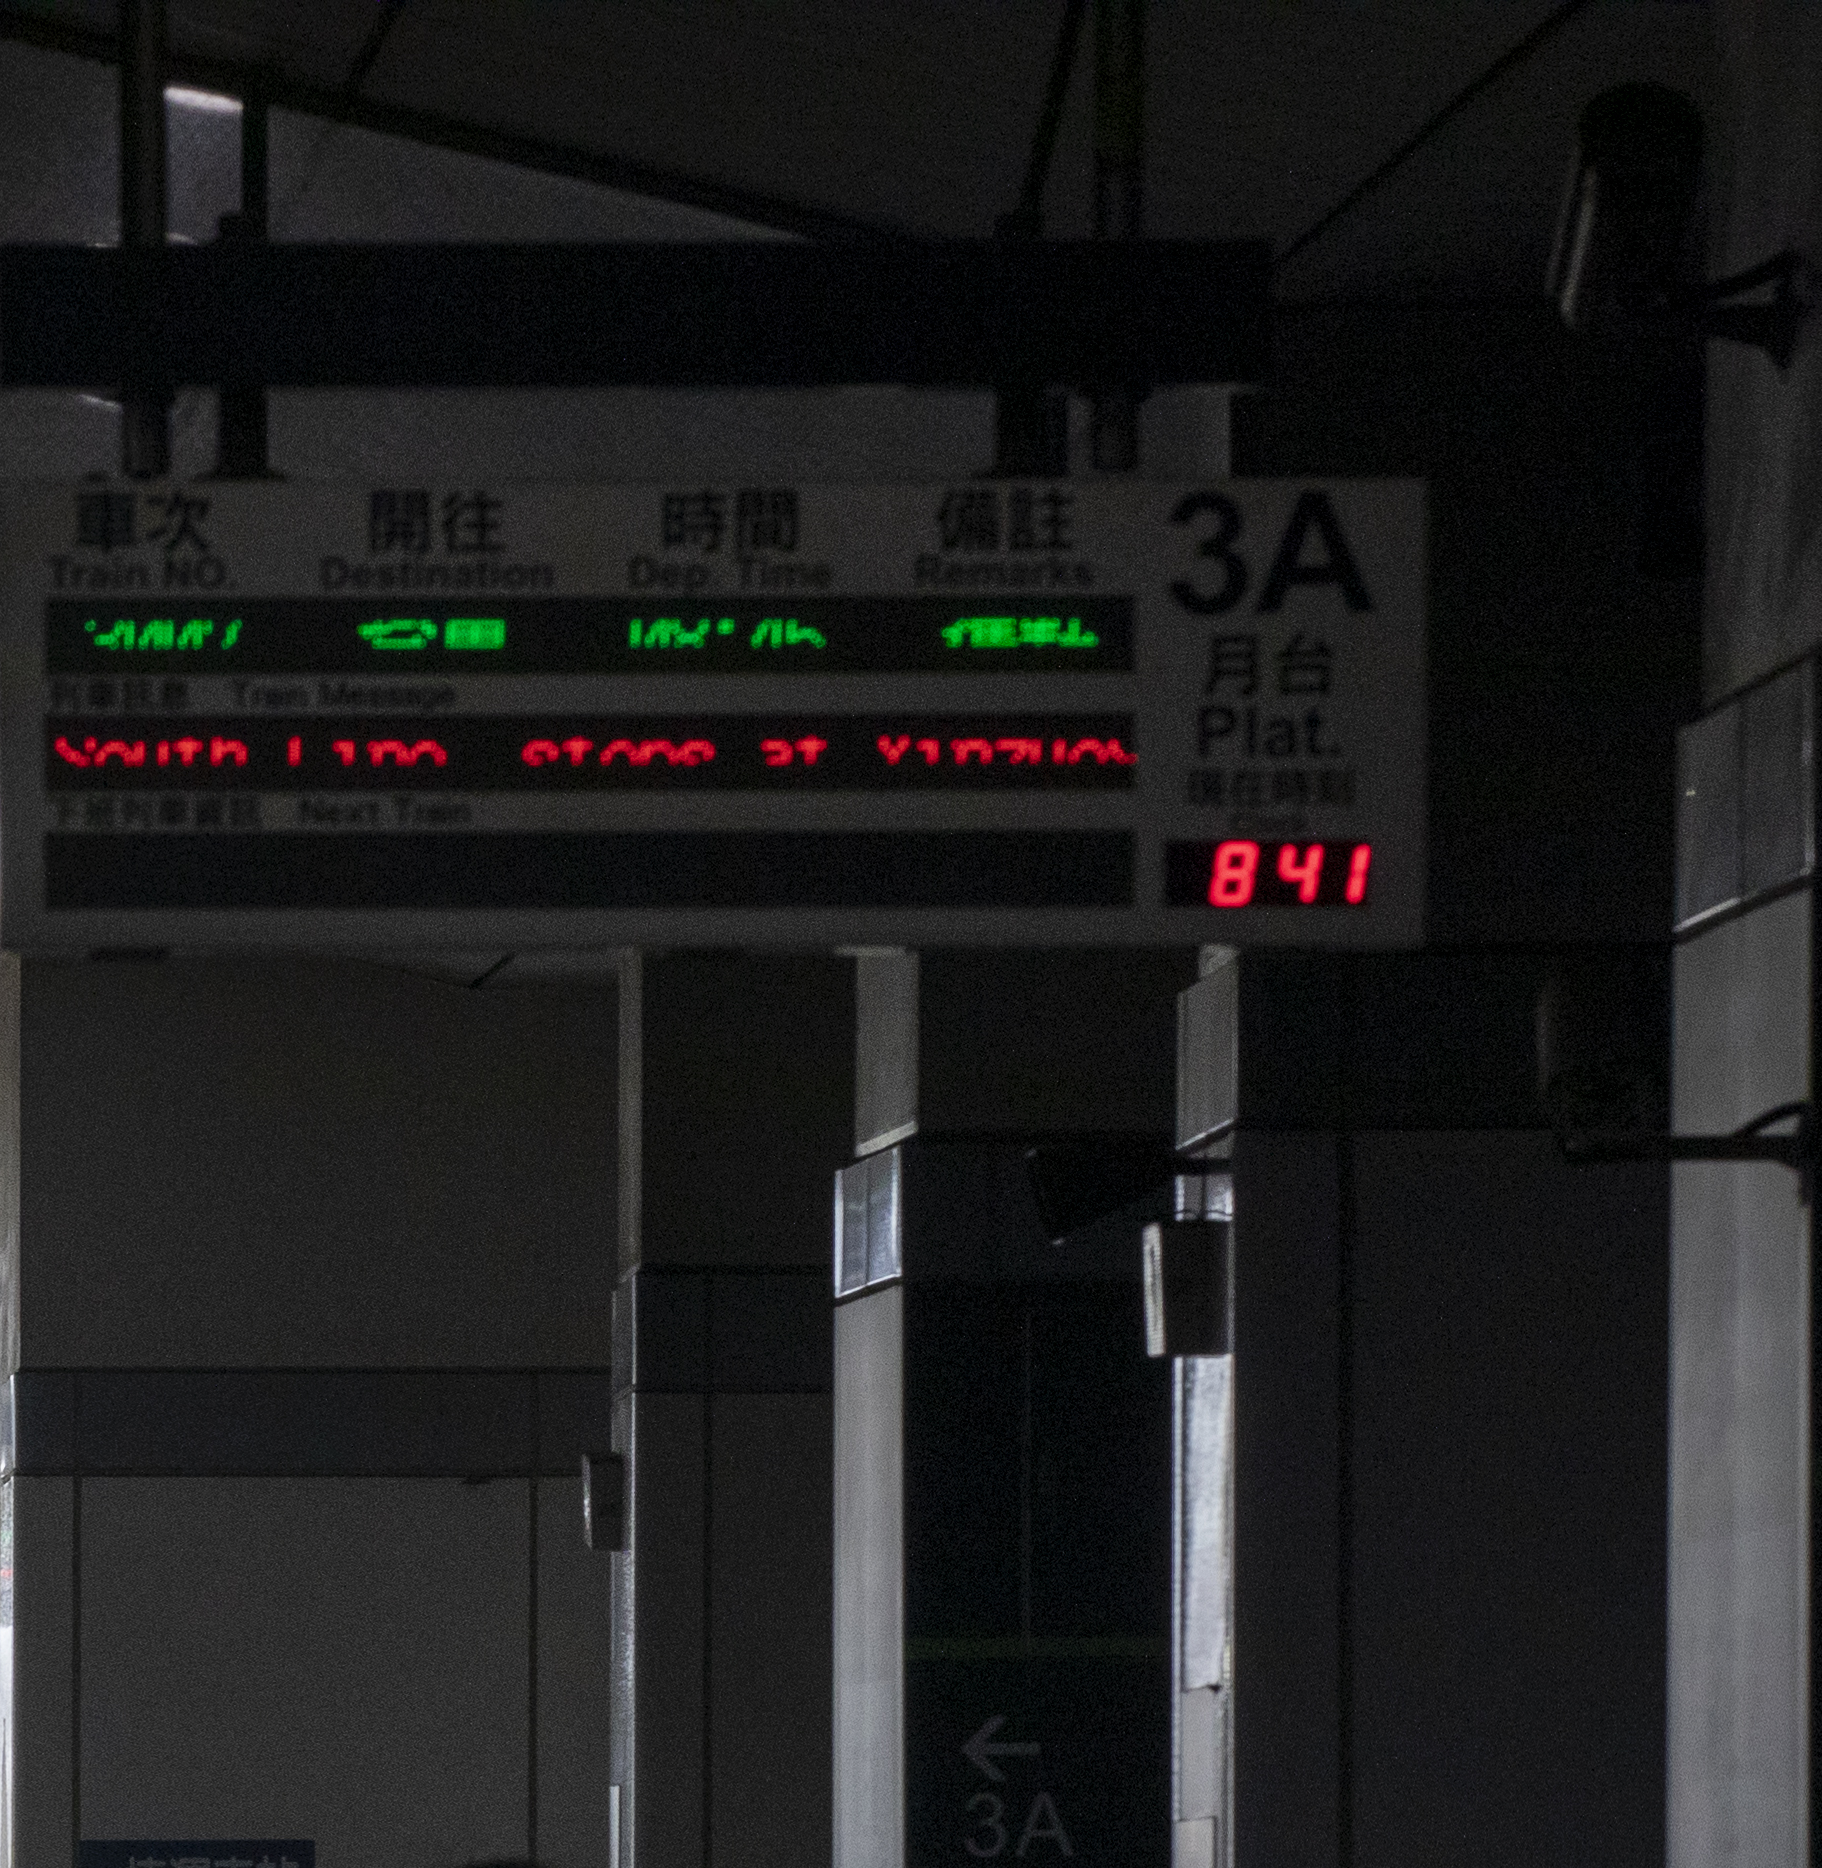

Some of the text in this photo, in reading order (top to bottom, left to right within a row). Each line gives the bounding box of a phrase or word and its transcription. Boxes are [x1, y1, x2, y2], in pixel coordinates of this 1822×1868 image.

[74, 492, 212, 552] 車次
[370, 491, 506, 552] 開往
[663, 490, 799, 550] 時間
[320, 556, 555, 588] Destination
[739, 555, 832, 586] Time
[914, 555, 1094, 586] Remarks
[1170, 493, 1372, 613] 3A
[1206, 632, 1332, 696] 月台
[1198, 706, 1340, 758] Plat.
[962, 1791, 1075, 1859] 3A
